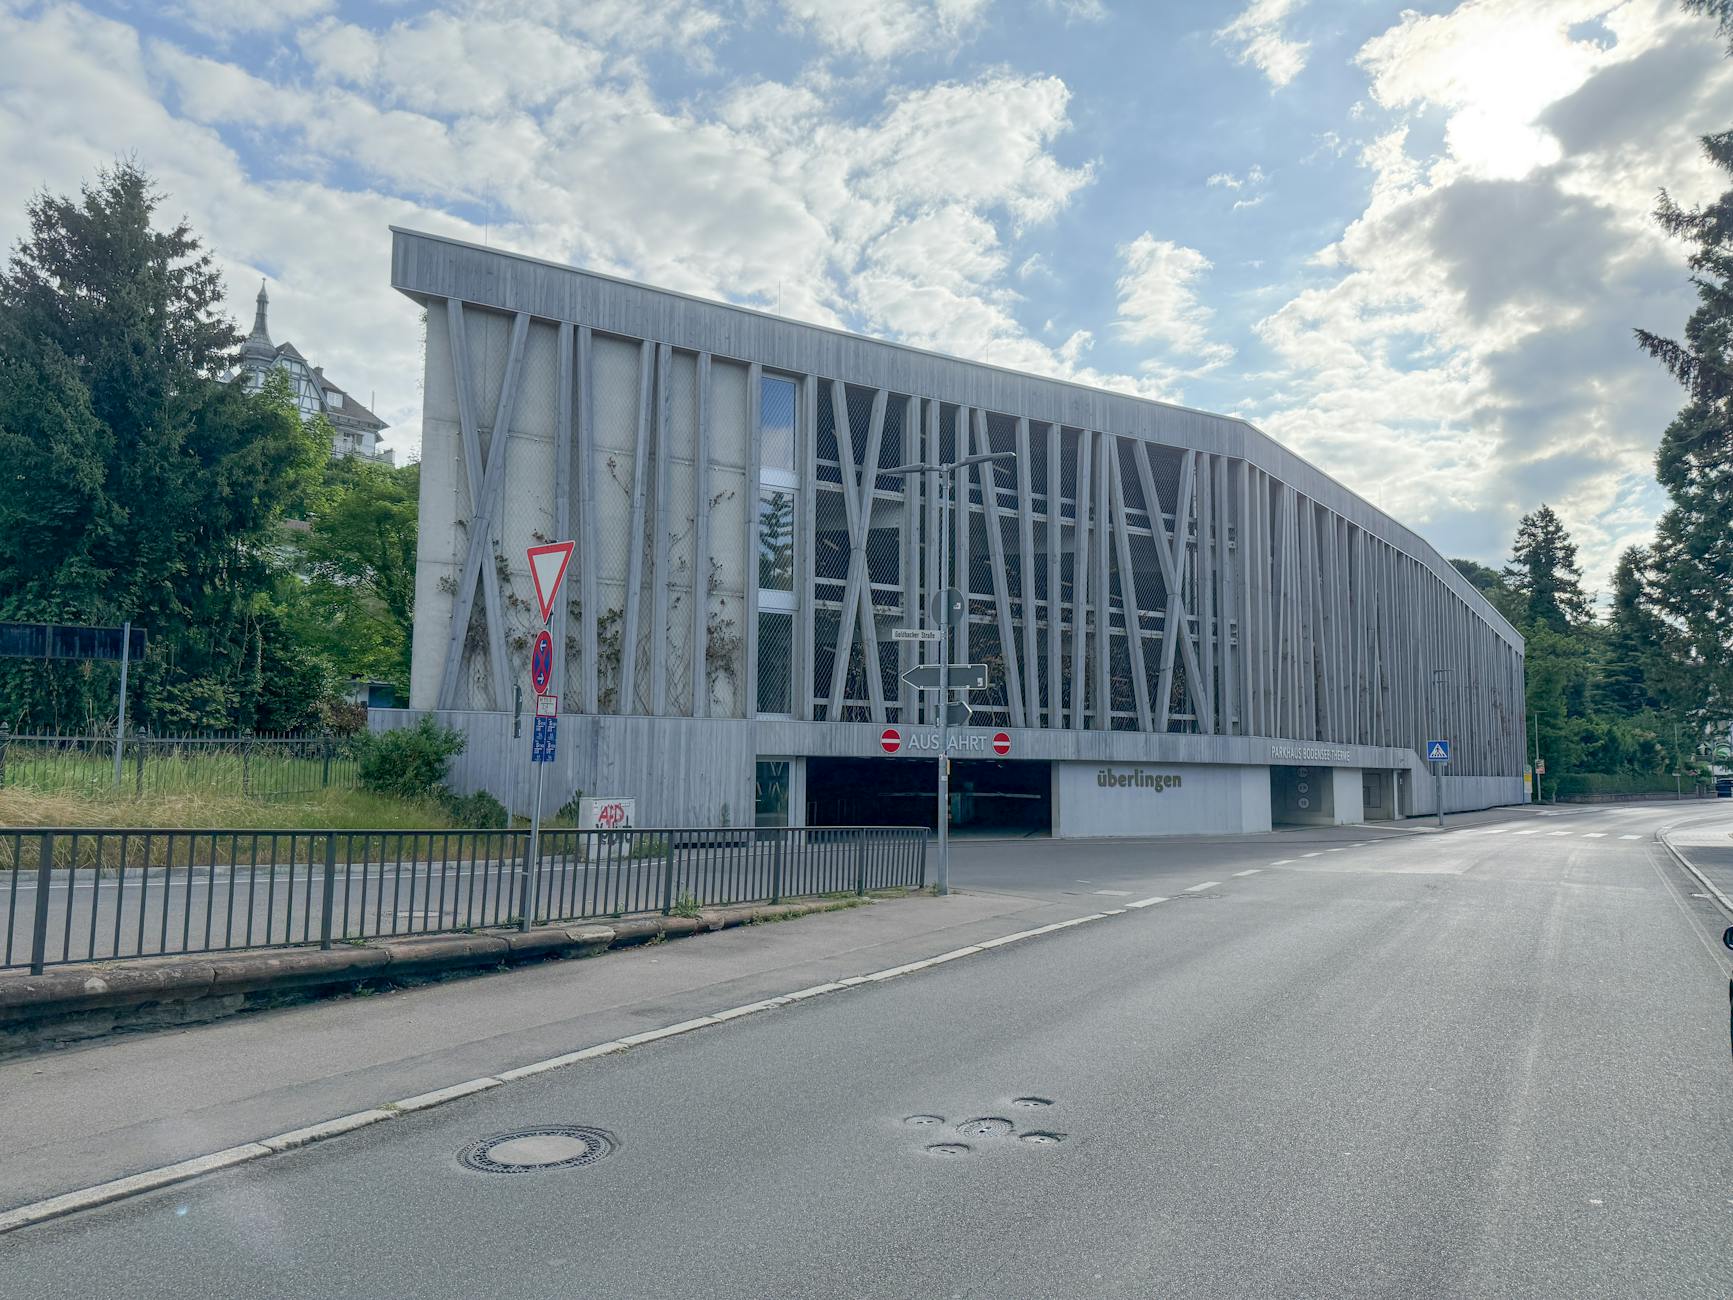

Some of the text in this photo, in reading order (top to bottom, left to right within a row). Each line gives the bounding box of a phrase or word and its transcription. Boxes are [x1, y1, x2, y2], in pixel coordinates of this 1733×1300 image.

[921, 631, 936, 639] Straße
[908, 734, 988, 752] AUSAHRT
[1271, 745, 1302, 760] PARKHAUS
[1097, 768, 1182, 793] überlingen
